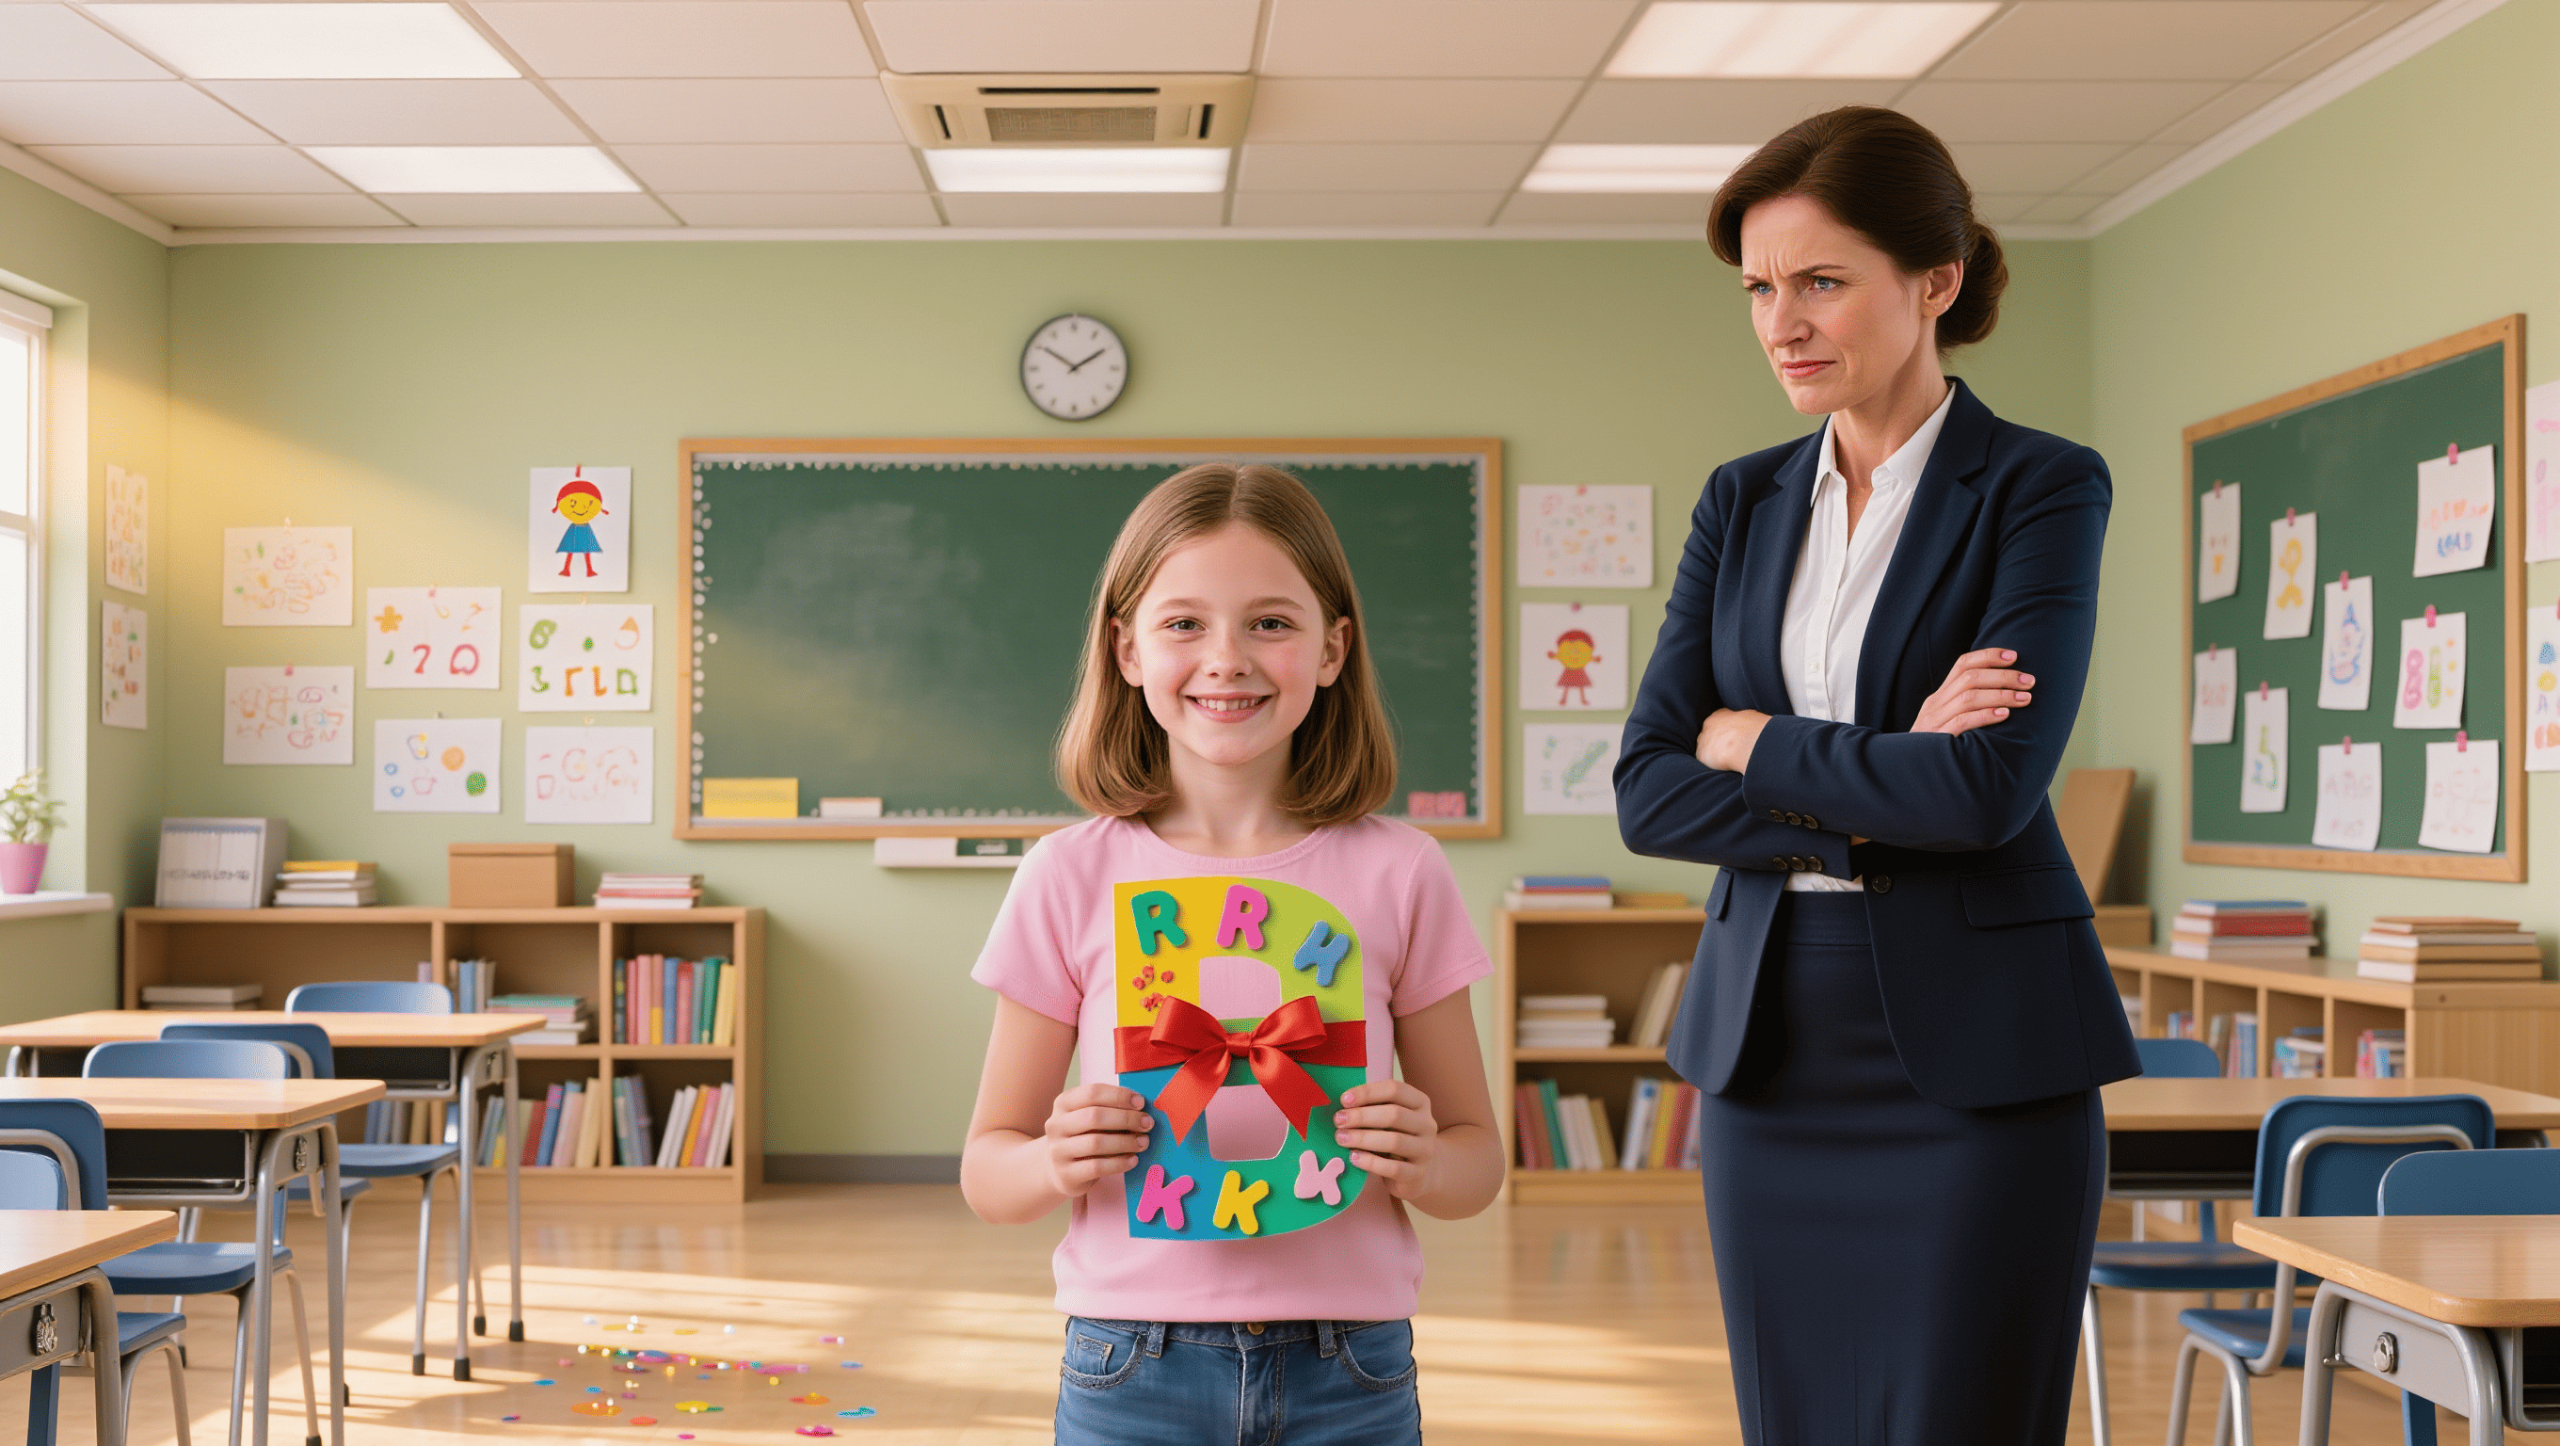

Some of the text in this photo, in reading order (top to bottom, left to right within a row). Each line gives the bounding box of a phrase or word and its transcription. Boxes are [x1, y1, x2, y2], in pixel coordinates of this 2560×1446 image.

[1130, 890, 1187, 955] R
[1216, 884, 1269, 950] R
[1136, 1164, 1195, 1231] K
[1212, 1170, 1270, 1235] K
